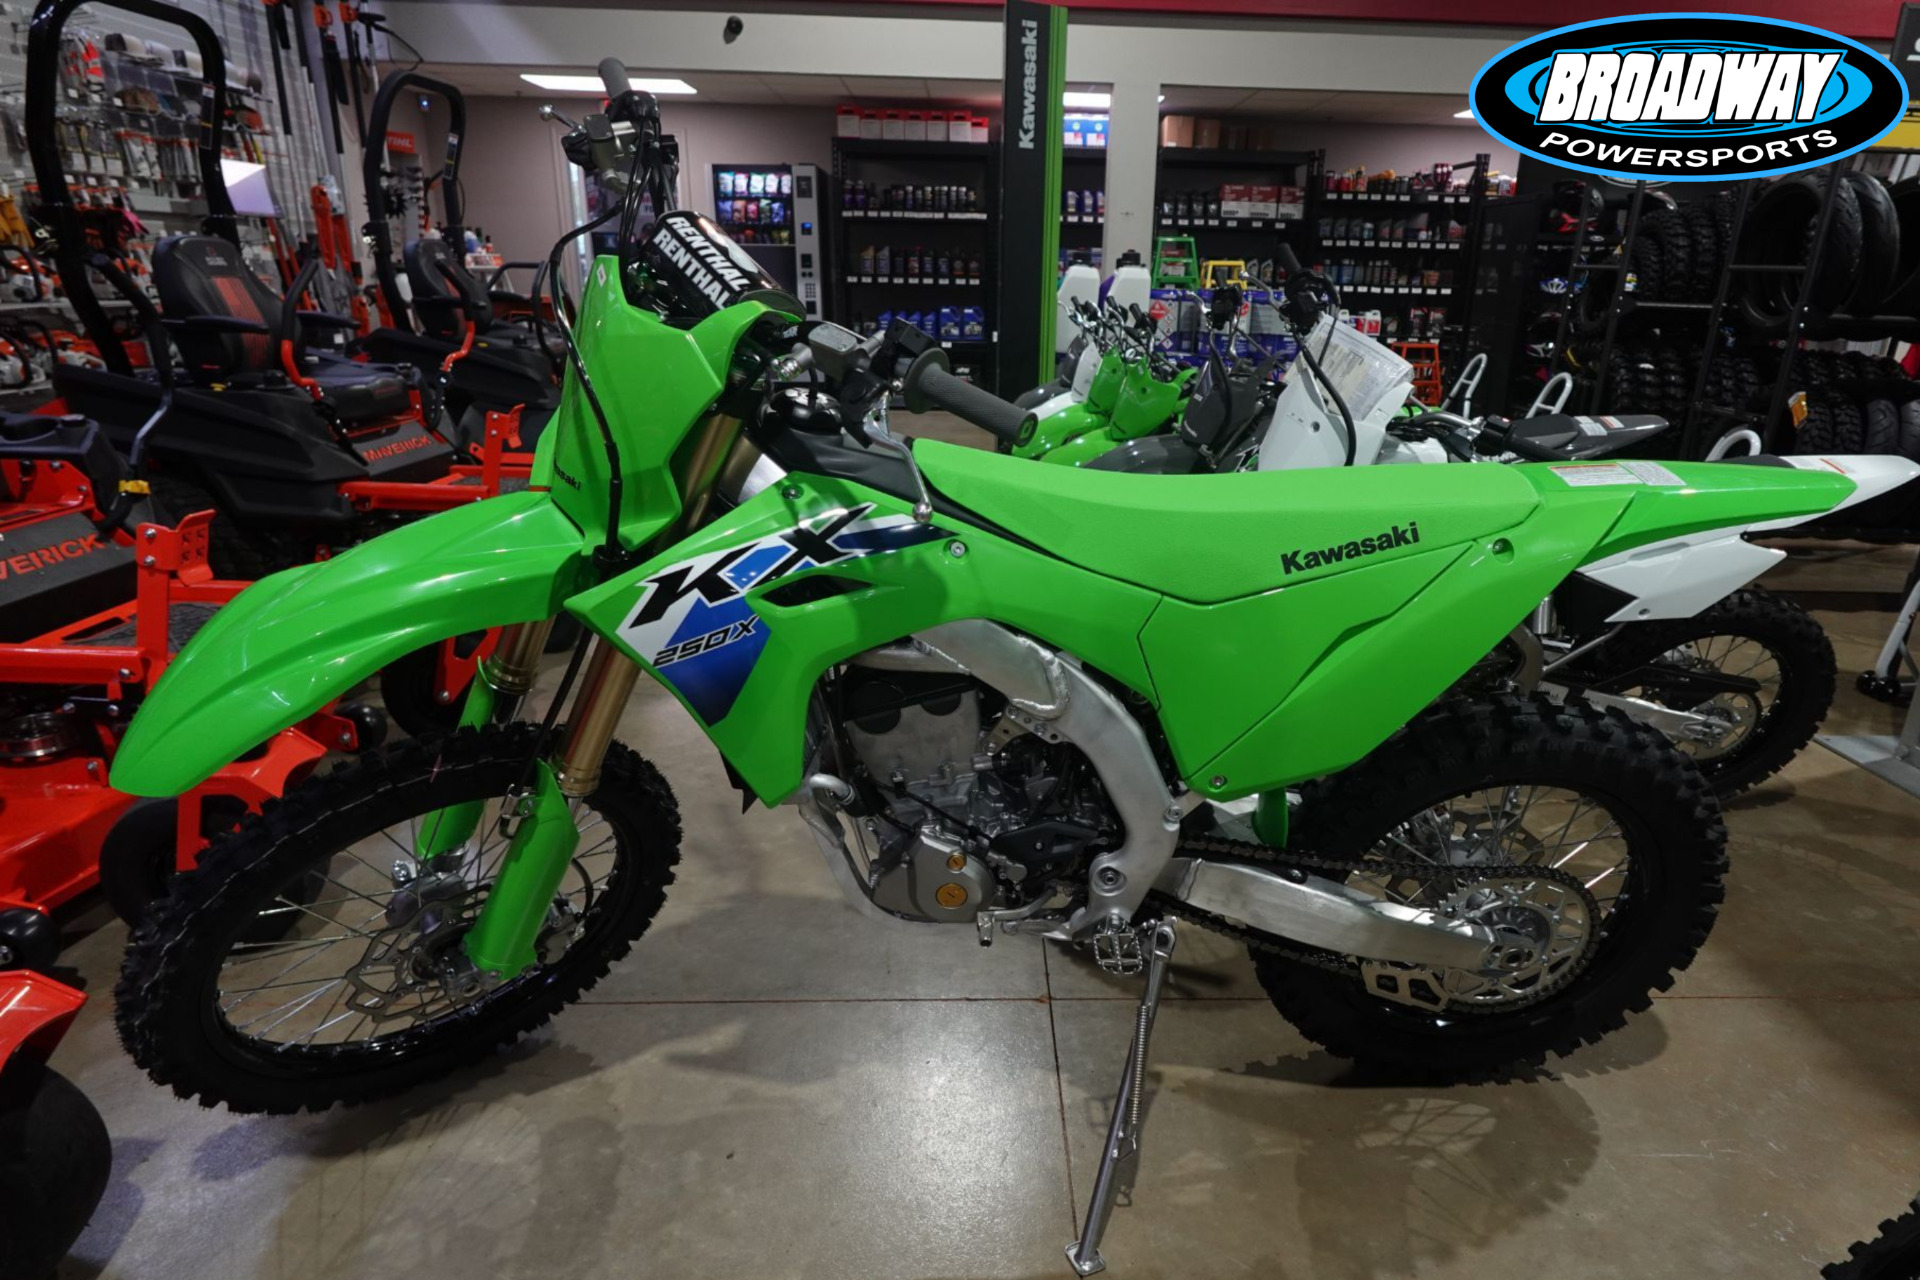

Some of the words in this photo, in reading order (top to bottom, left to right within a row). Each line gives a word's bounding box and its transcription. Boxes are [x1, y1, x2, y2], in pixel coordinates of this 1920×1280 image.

[1019, 19, 1038, 150] Kawasaki
[386, 136, 413, 147] TIHL
[653, 228, 732, 309] RENTHAL
[666, 217, 751, 291] RENTHAL
[363, 435, 432, 461] MAVERICK
[629, 502, 877, 628] KX
[1280, 521, 1420, 575] Kawasaki
[652, 615, 760, 667] 250X
